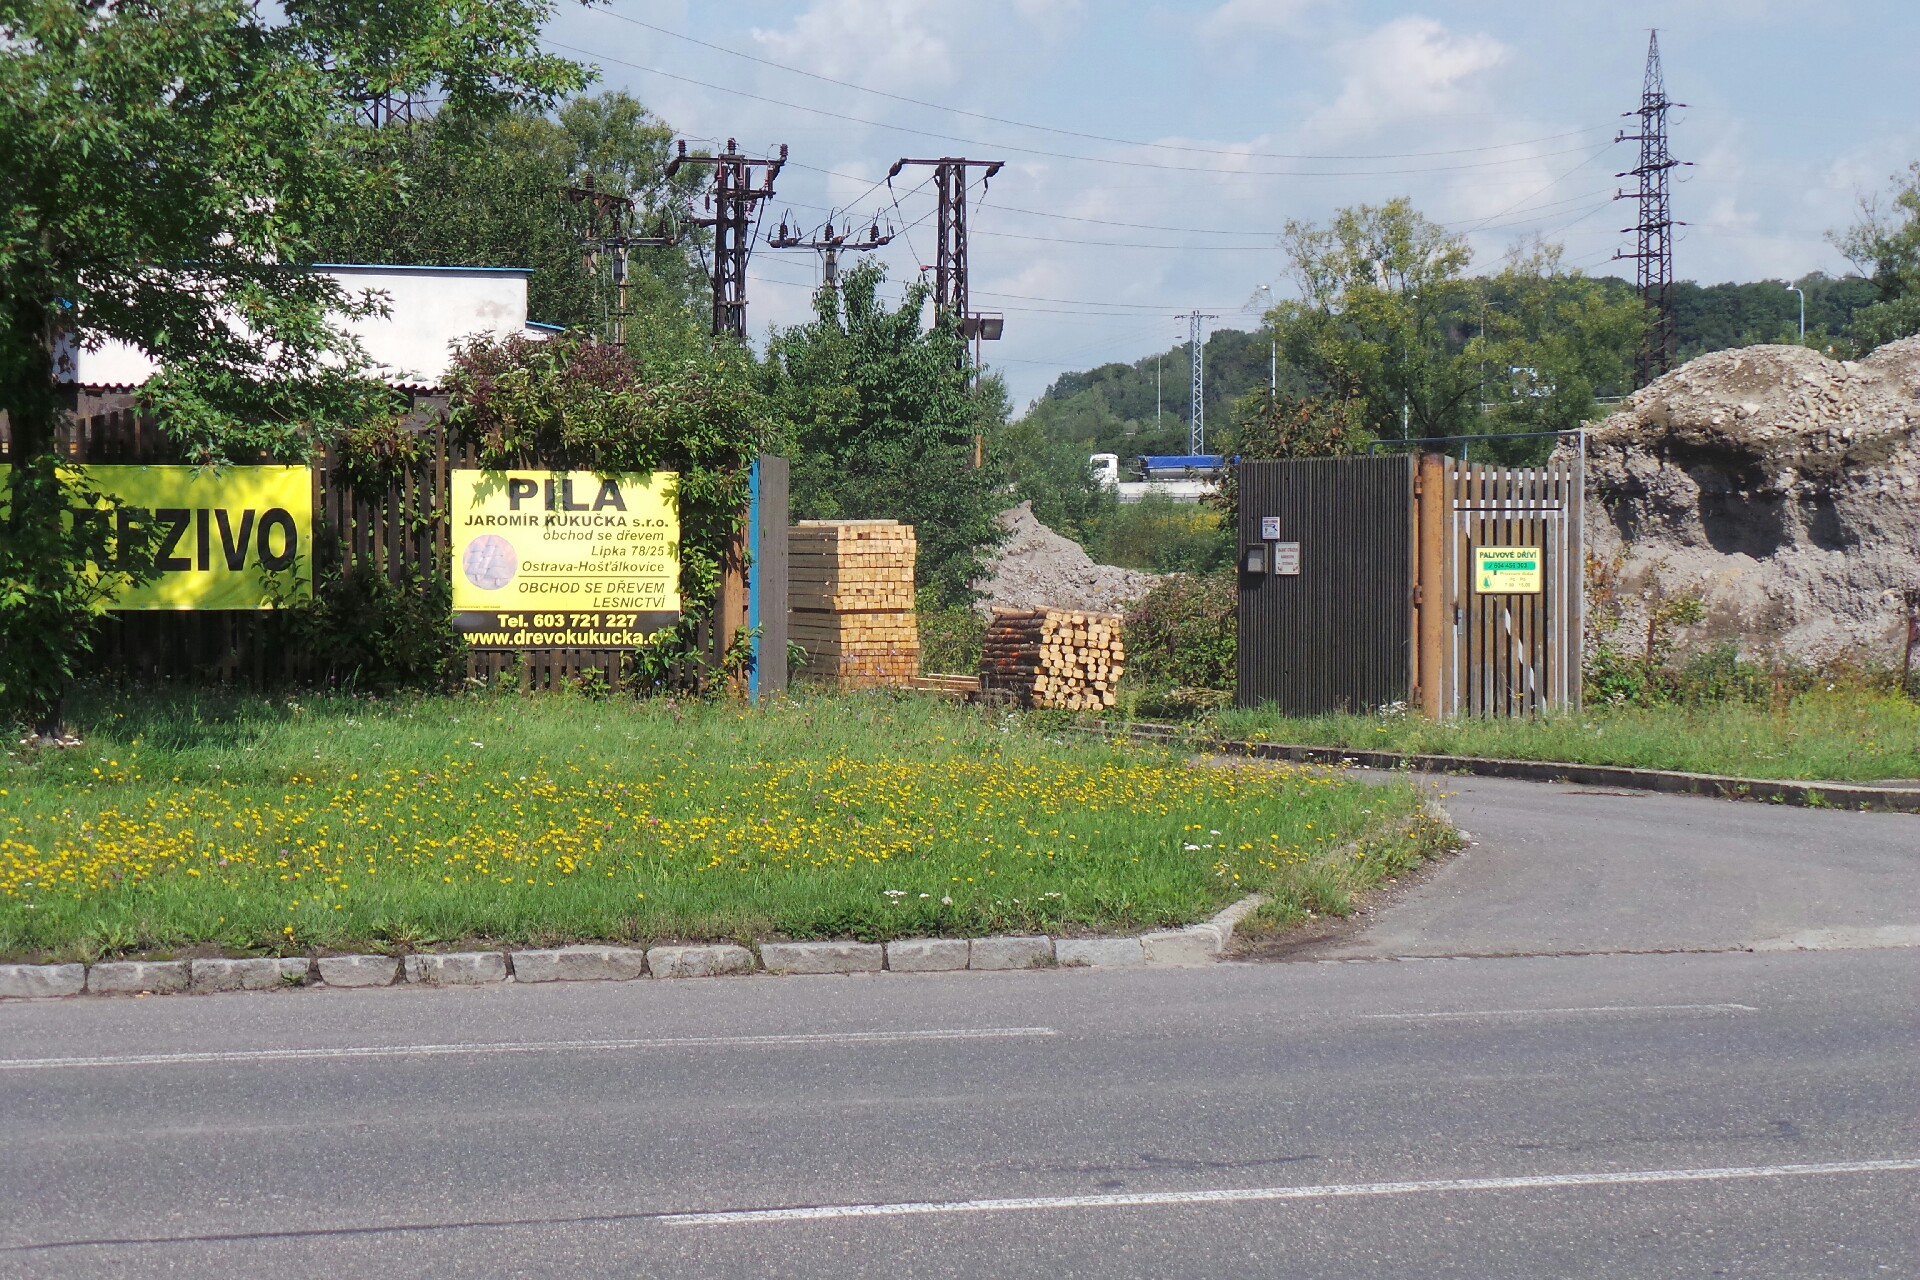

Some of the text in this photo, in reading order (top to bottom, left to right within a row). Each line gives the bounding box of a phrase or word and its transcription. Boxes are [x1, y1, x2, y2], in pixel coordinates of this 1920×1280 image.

[509, 478, 627, 511] PILA
[465, 513, 669, 528] JAROMÍR KUKUČKA s.r.o.
[543, 530, 664, 541] obchod se dřevem
[591, 546, 664, 557] Lipka 78/25
[1517, 550, 1536, 558] DŘÍVÍ
[522, 561, 665, 572] Ostrava-Hošťálkovice
[519, 580, 665, 594] OBCHOD SE DŘEVEM
[593, 596, 665, 608] LESNICTVÍ
[498, 615, 637, 627] Tel. 603 721 227
[464, 630, 668, 645] www.drevokukucka.c
